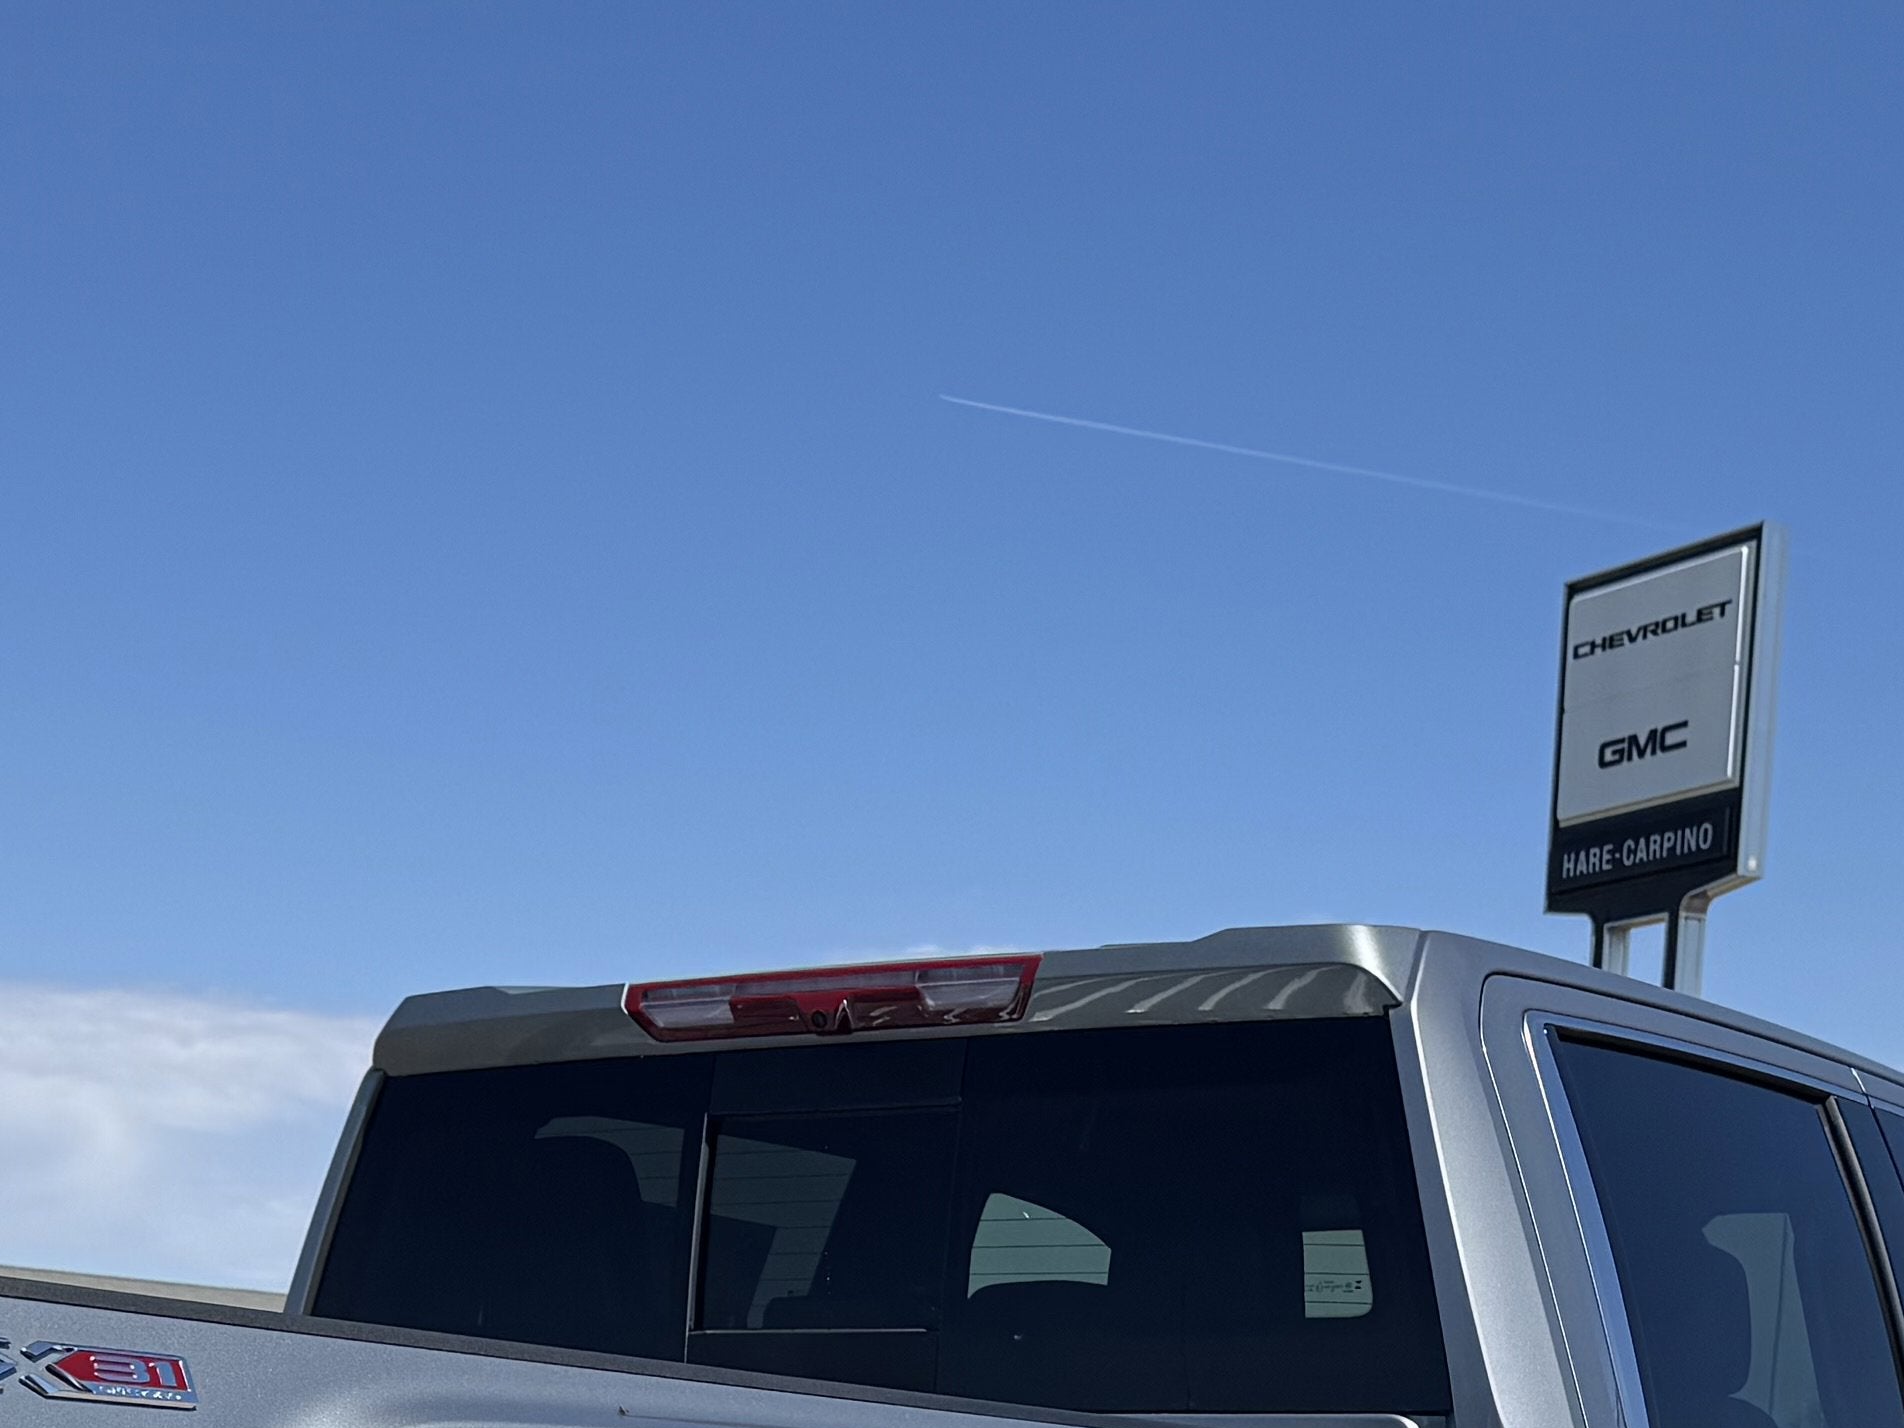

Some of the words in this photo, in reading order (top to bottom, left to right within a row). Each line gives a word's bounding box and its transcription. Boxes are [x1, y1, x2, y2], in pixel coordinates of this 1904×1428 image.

[1573, 599, 1733, 660] CHEVROLET
[1598, 720, 1690, 770] GMC
[1562, 822, 1714, 880] HARE-CARPINO
